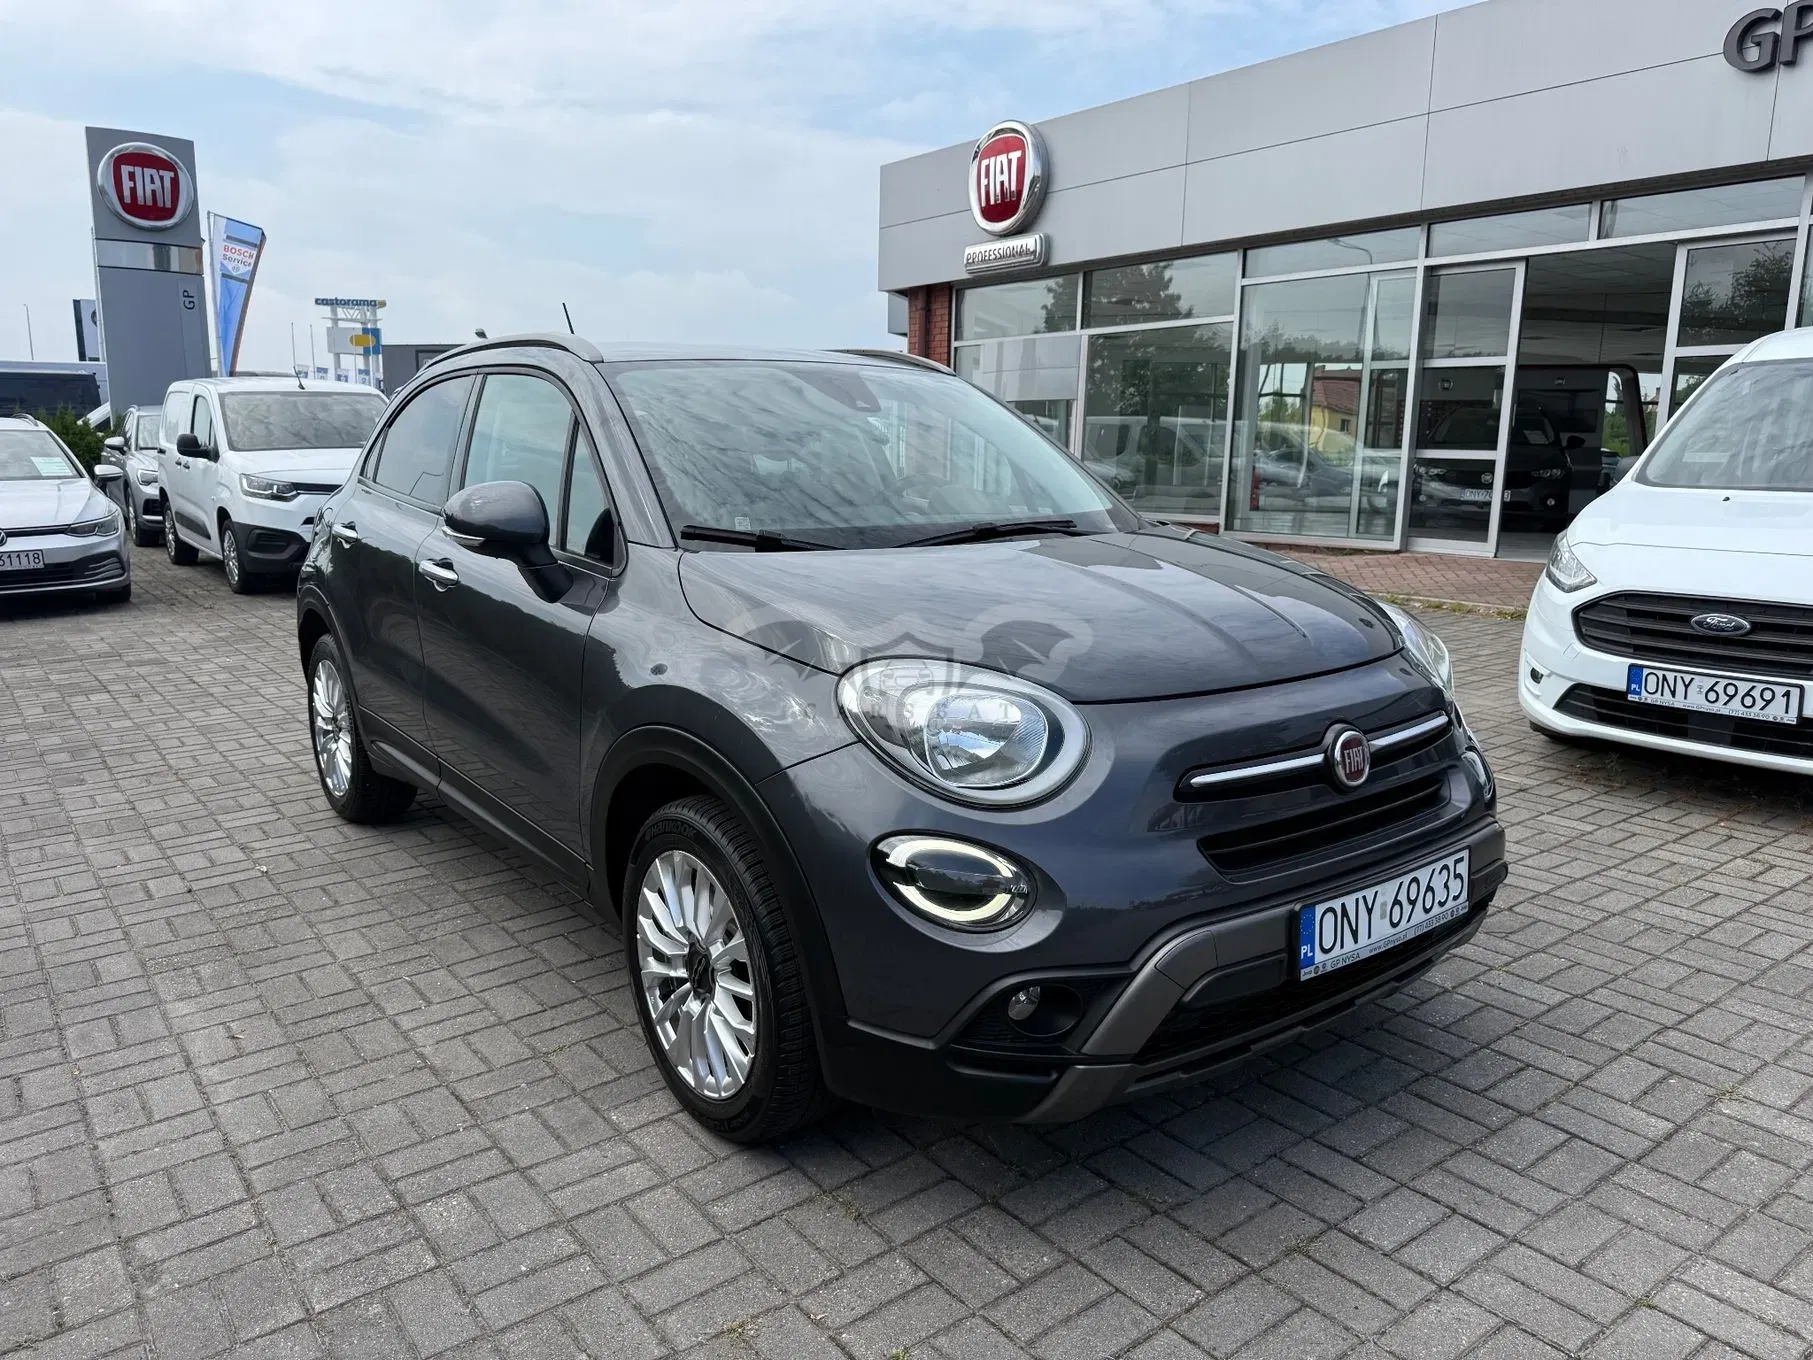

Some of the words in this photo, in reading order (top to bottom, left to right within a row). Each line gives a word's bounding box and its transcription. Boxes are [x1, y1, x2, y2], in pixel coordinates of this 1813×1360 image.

[1723, 0, 1813, 73] GP
[120, 164, 175, 209] FIAT
[980, 150, 1022, 208] FIAT
[222, 253, 252, 267] Service
[223, 244, 255, 259] BOSCH
[966, 243, 1031, 265] PROFESSIONAL
[182, 289, 196, 310] GP
[314, 297, 377, 307] castorama
[1631, 684, 1640, 692] PL
[1644, 671, 1695, 700] ONY
[1704, 680, 1791, 714] 69691
[1344, 746, 1364, 773] FIAT
[1318, 891, 1378, 955] ONY
[1388, 856, 1465, 929] 69635
[1301, 944, 1313, 959] PL
[1330, 960, 1340, 969] GP
[1341, 952, 1360, 965] NYSA
